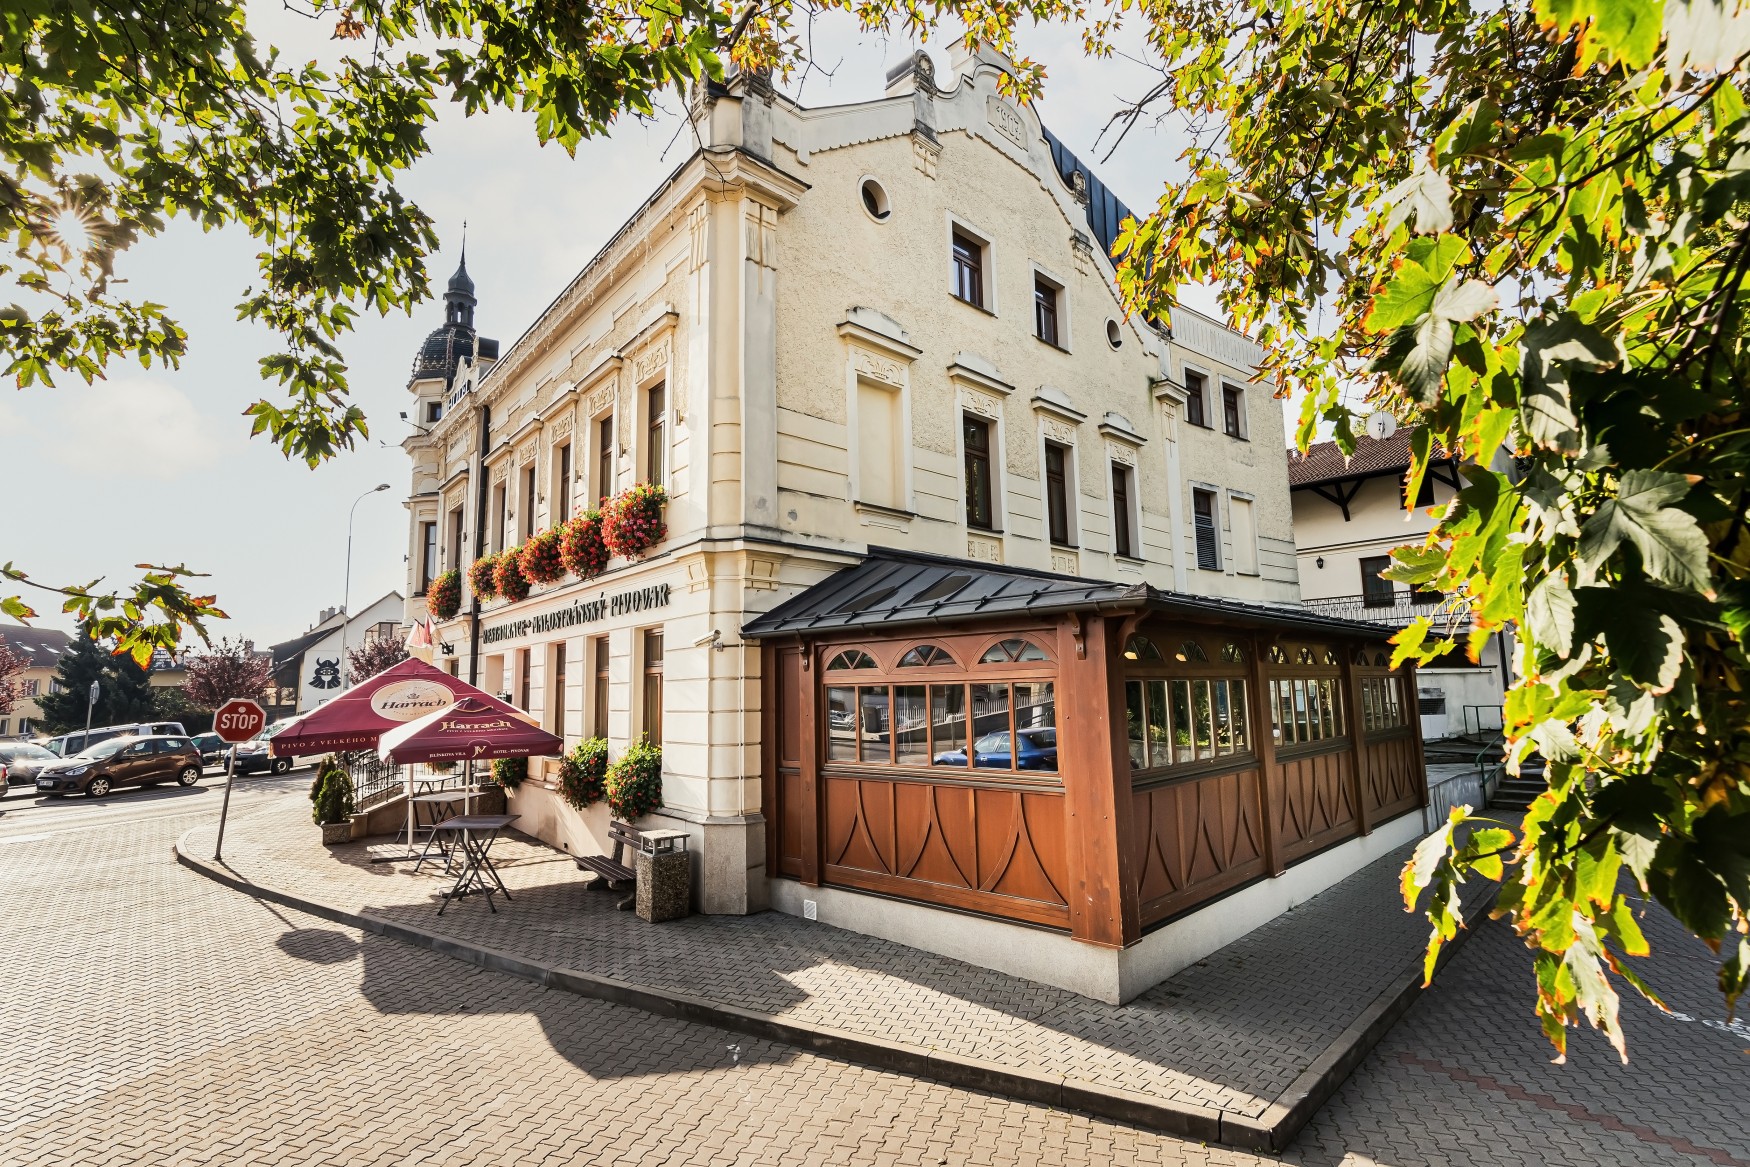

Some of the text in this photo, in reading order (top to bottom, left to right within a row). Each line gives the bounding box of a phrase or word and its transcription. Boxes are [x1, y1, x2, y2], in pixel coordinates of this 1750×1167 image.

[482, 583, 669, 645] RESTAURACE MALOSTRÁNSKÝ PIVOVAR
[380, 699, 447, 709] Harrach
[220, 713, 259, 730] STOP
[438, 719, 516, 732] Harrach
[320, 736, 366, 745] VELKÉHO
